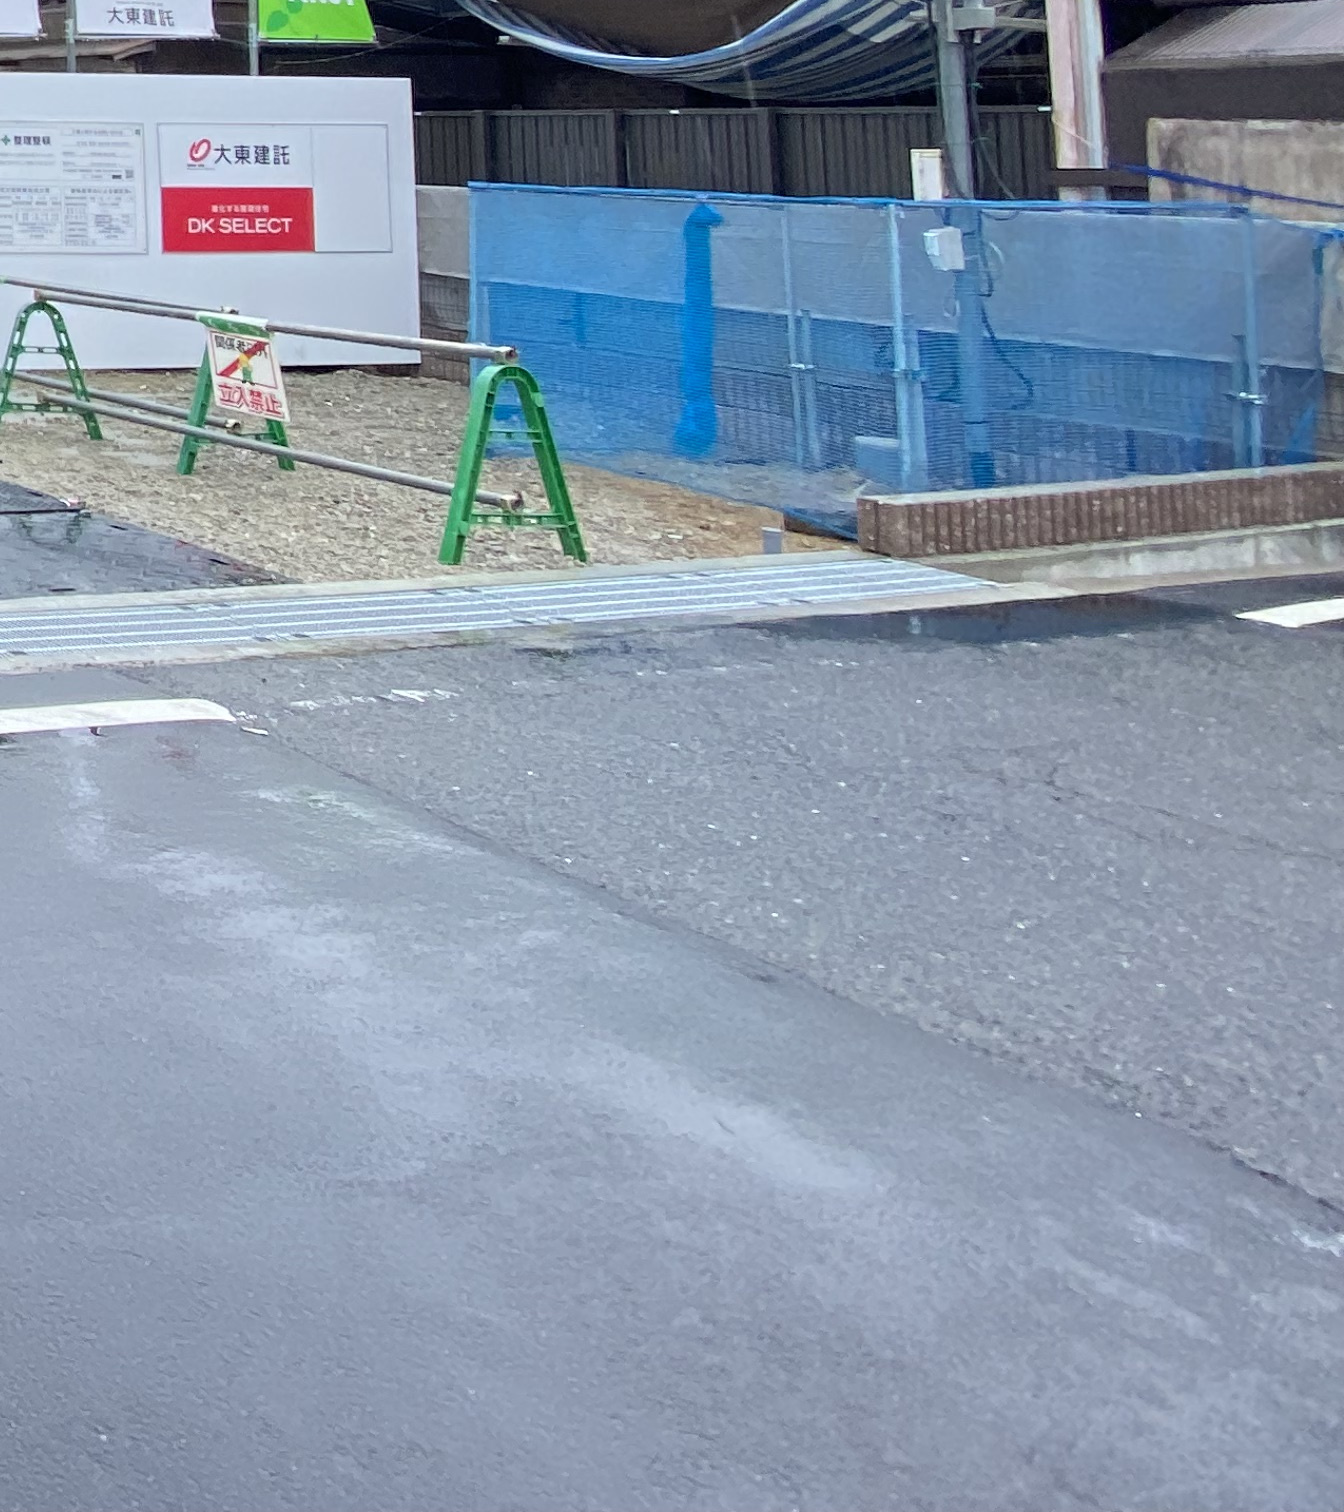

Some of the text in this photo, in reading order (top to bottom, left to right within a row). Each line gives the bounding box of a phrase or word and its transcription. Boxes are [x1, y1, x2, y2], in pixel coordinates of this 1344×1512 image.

[106, 6, 176, 28] 大東建託
[214, 143, 291, 166] 大東建託
[187, 217, 294, 234] DK SELECT
[214, 334, 269, 359] 関係者
[217, 382, 282, 416] 立入禁止
